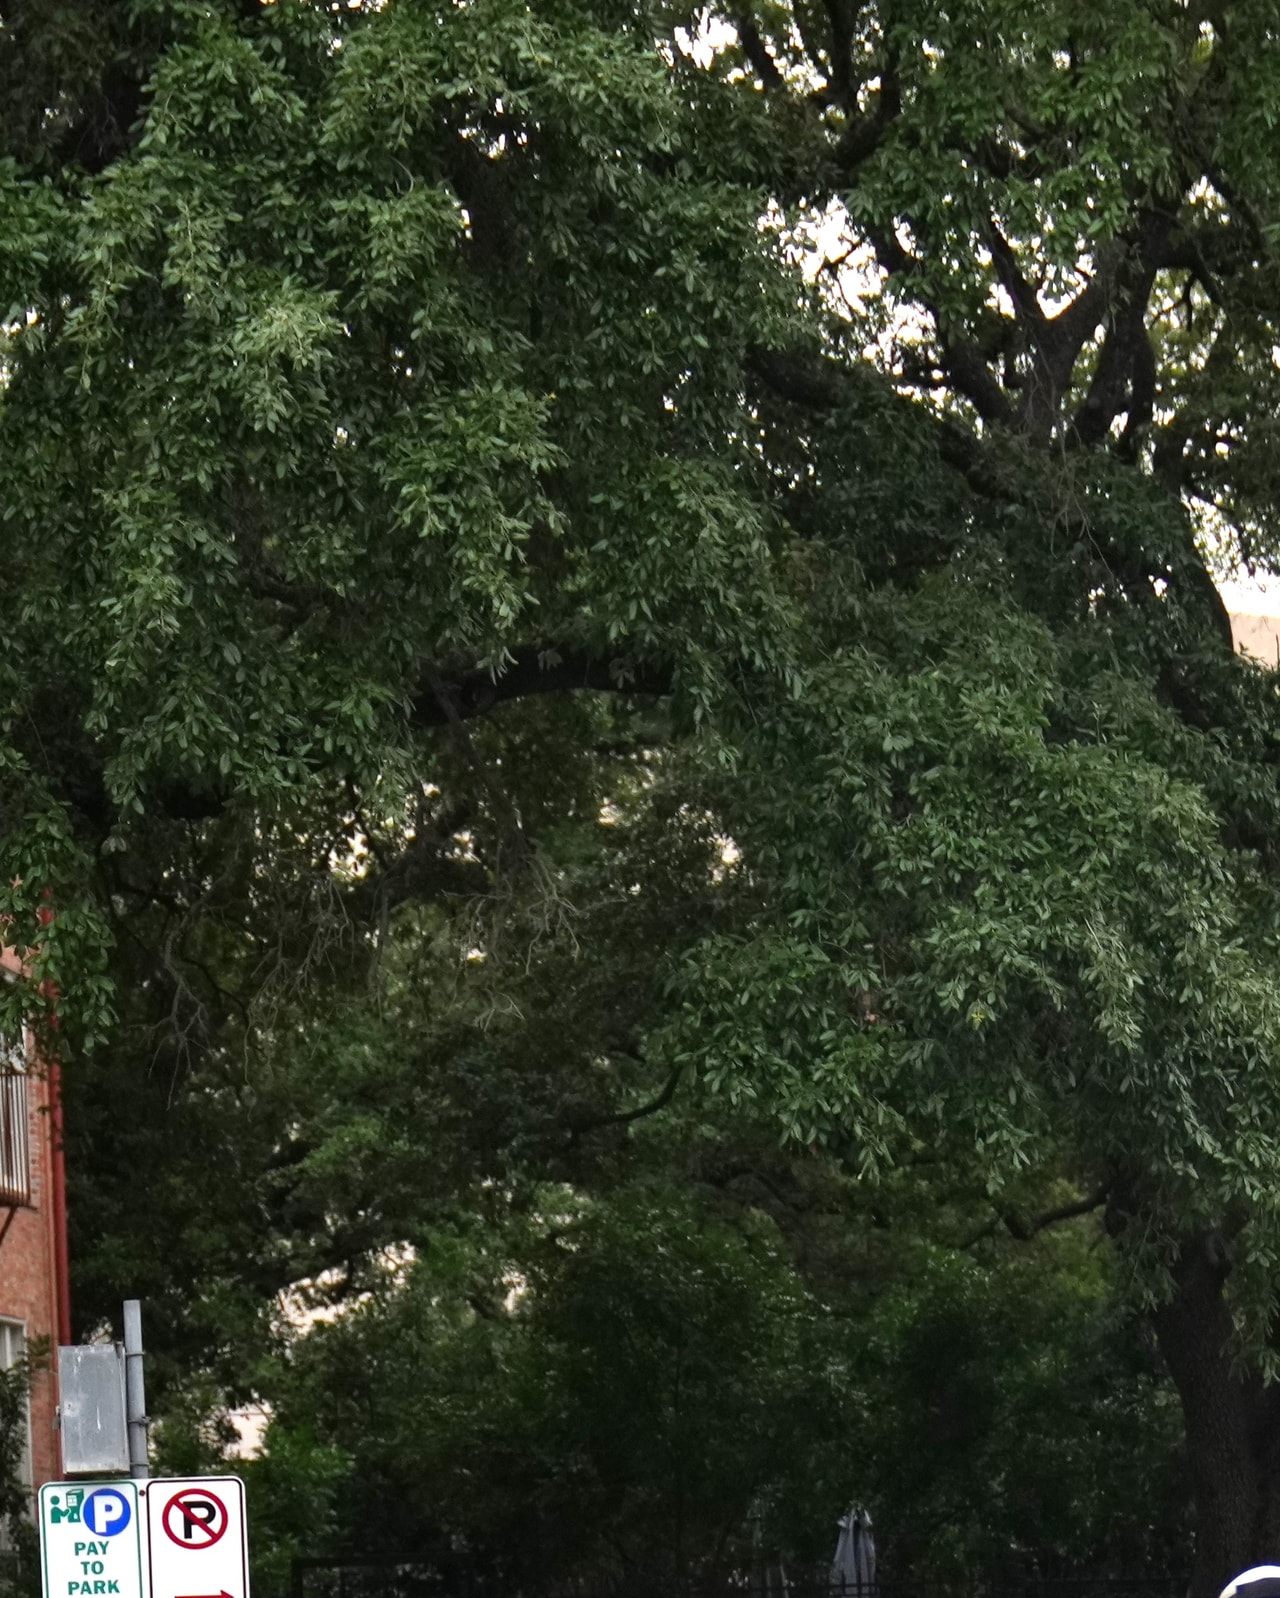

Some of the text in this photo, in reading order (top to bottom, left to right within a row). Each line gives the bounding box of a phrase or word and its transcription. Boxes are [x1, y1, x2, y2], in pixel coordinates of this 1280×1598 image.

[93, 1495, 124, 1533] P
[74, 1541, 110, 1556] PAY
[81, 1561, 104, 1575] TO
[68, 1579, 120, 1595] PARK
